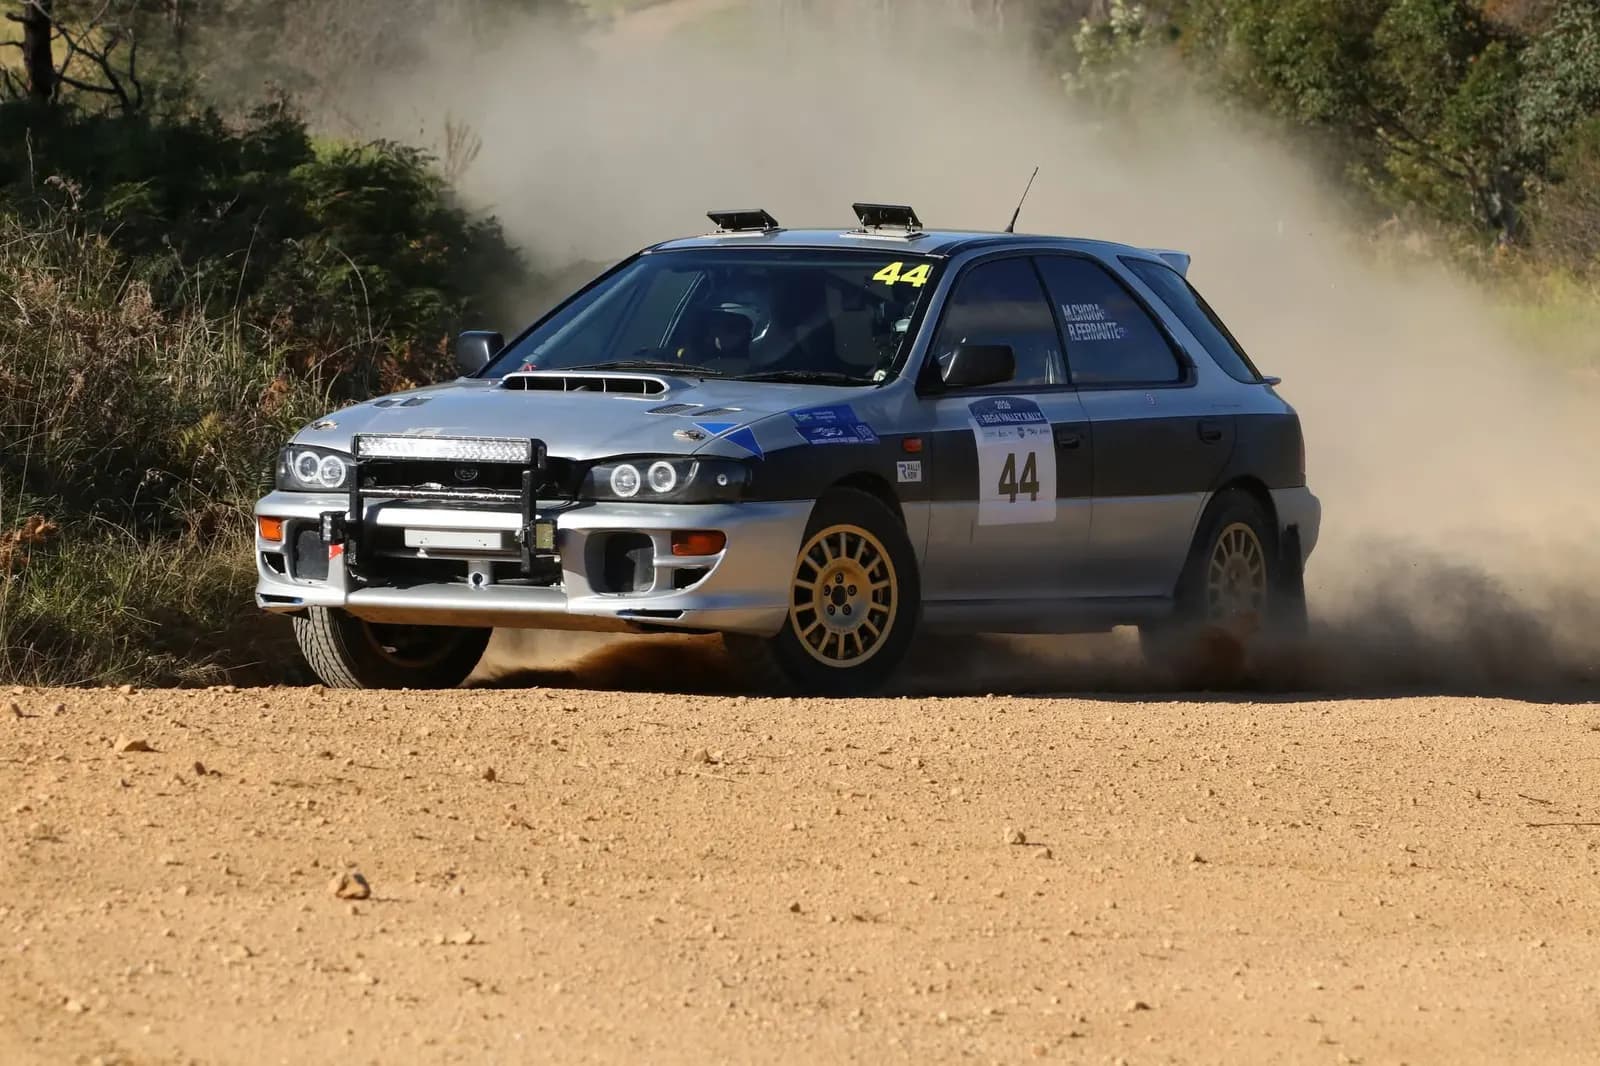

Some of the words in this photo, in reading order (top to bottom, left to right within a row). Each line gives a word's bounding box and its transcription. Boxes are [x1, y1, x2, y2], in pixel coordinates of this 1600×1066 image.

[872, 261, 930, 288] 44
[1000, 412, 1022, 422] VALLEY
[1022, 412, 1042, 421] RALLY
[998, 451, 1040, 503] 44
